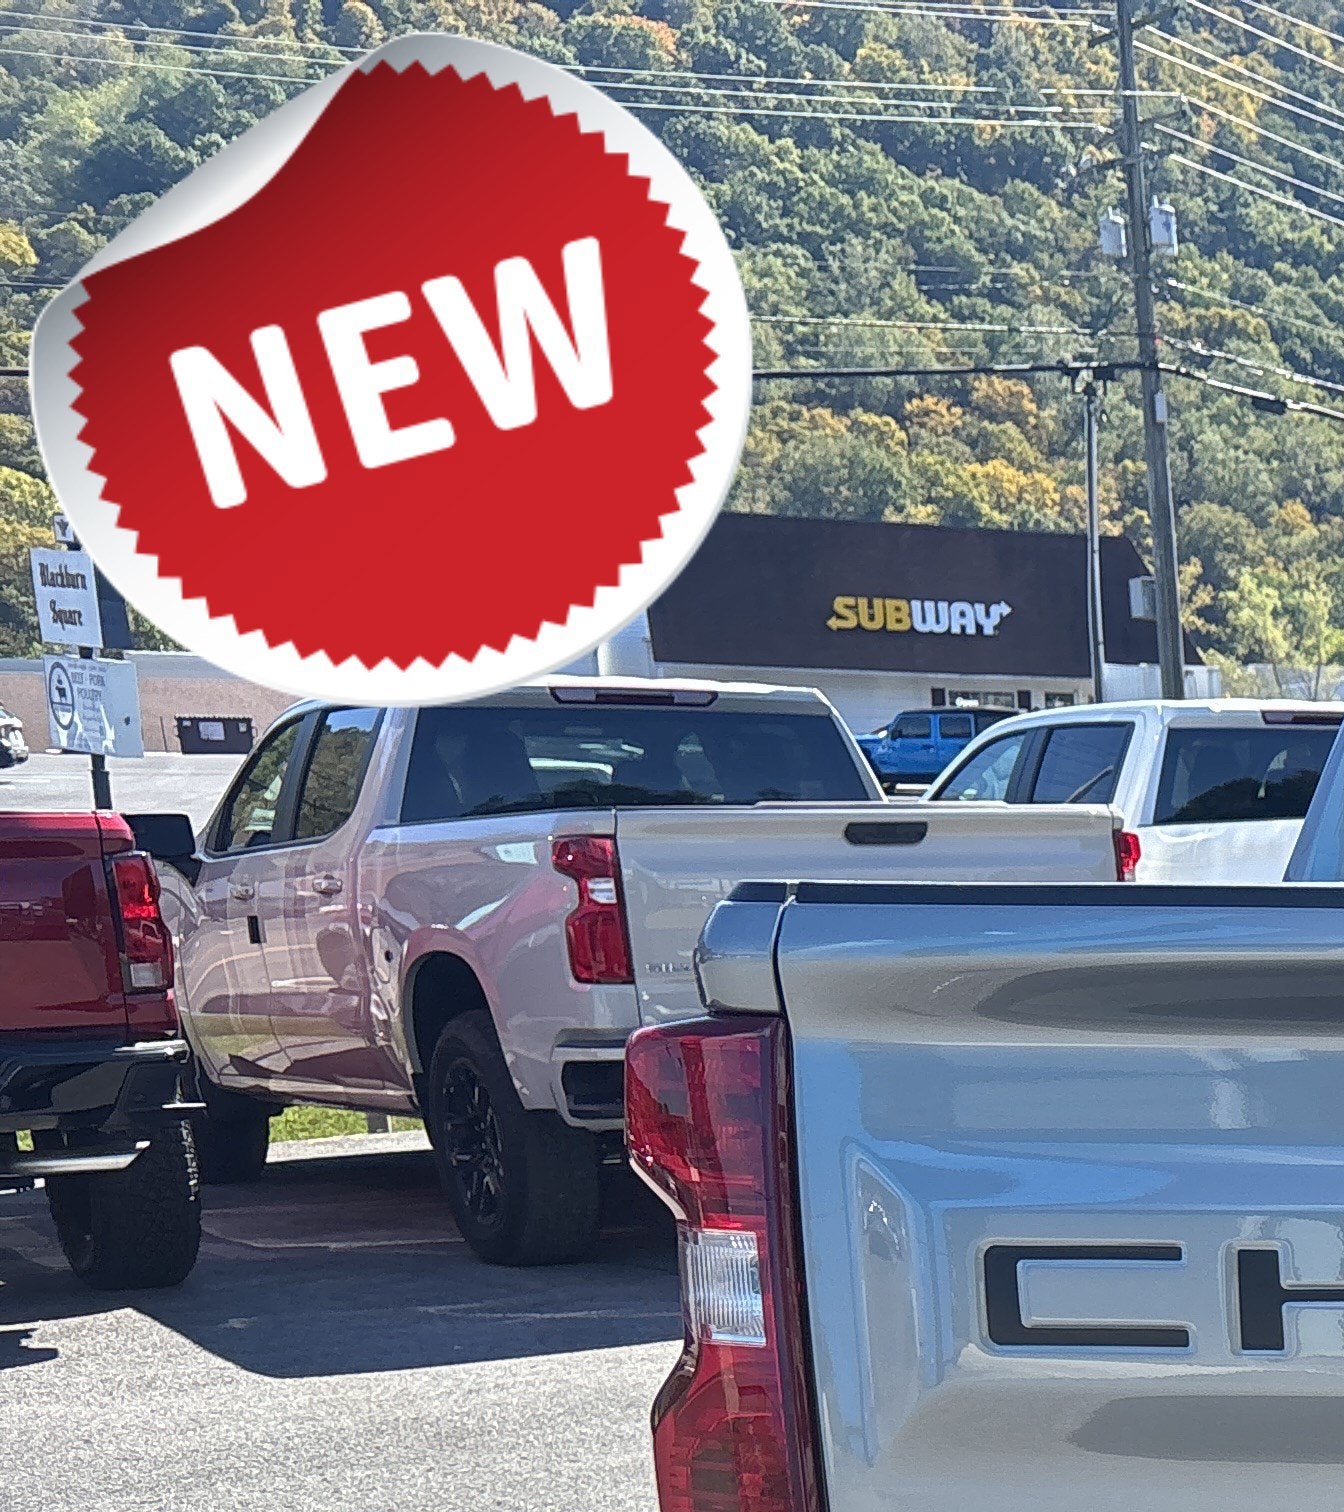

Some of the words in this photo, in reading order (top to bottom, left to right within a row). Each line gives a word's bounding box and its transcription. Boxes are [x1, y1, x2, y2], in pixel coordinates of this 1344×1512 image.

[39, 562, 87, 590] Blackburn
[50, 599, 83, 631] Square
[826, 595, 1012, 636] SUBWAY
